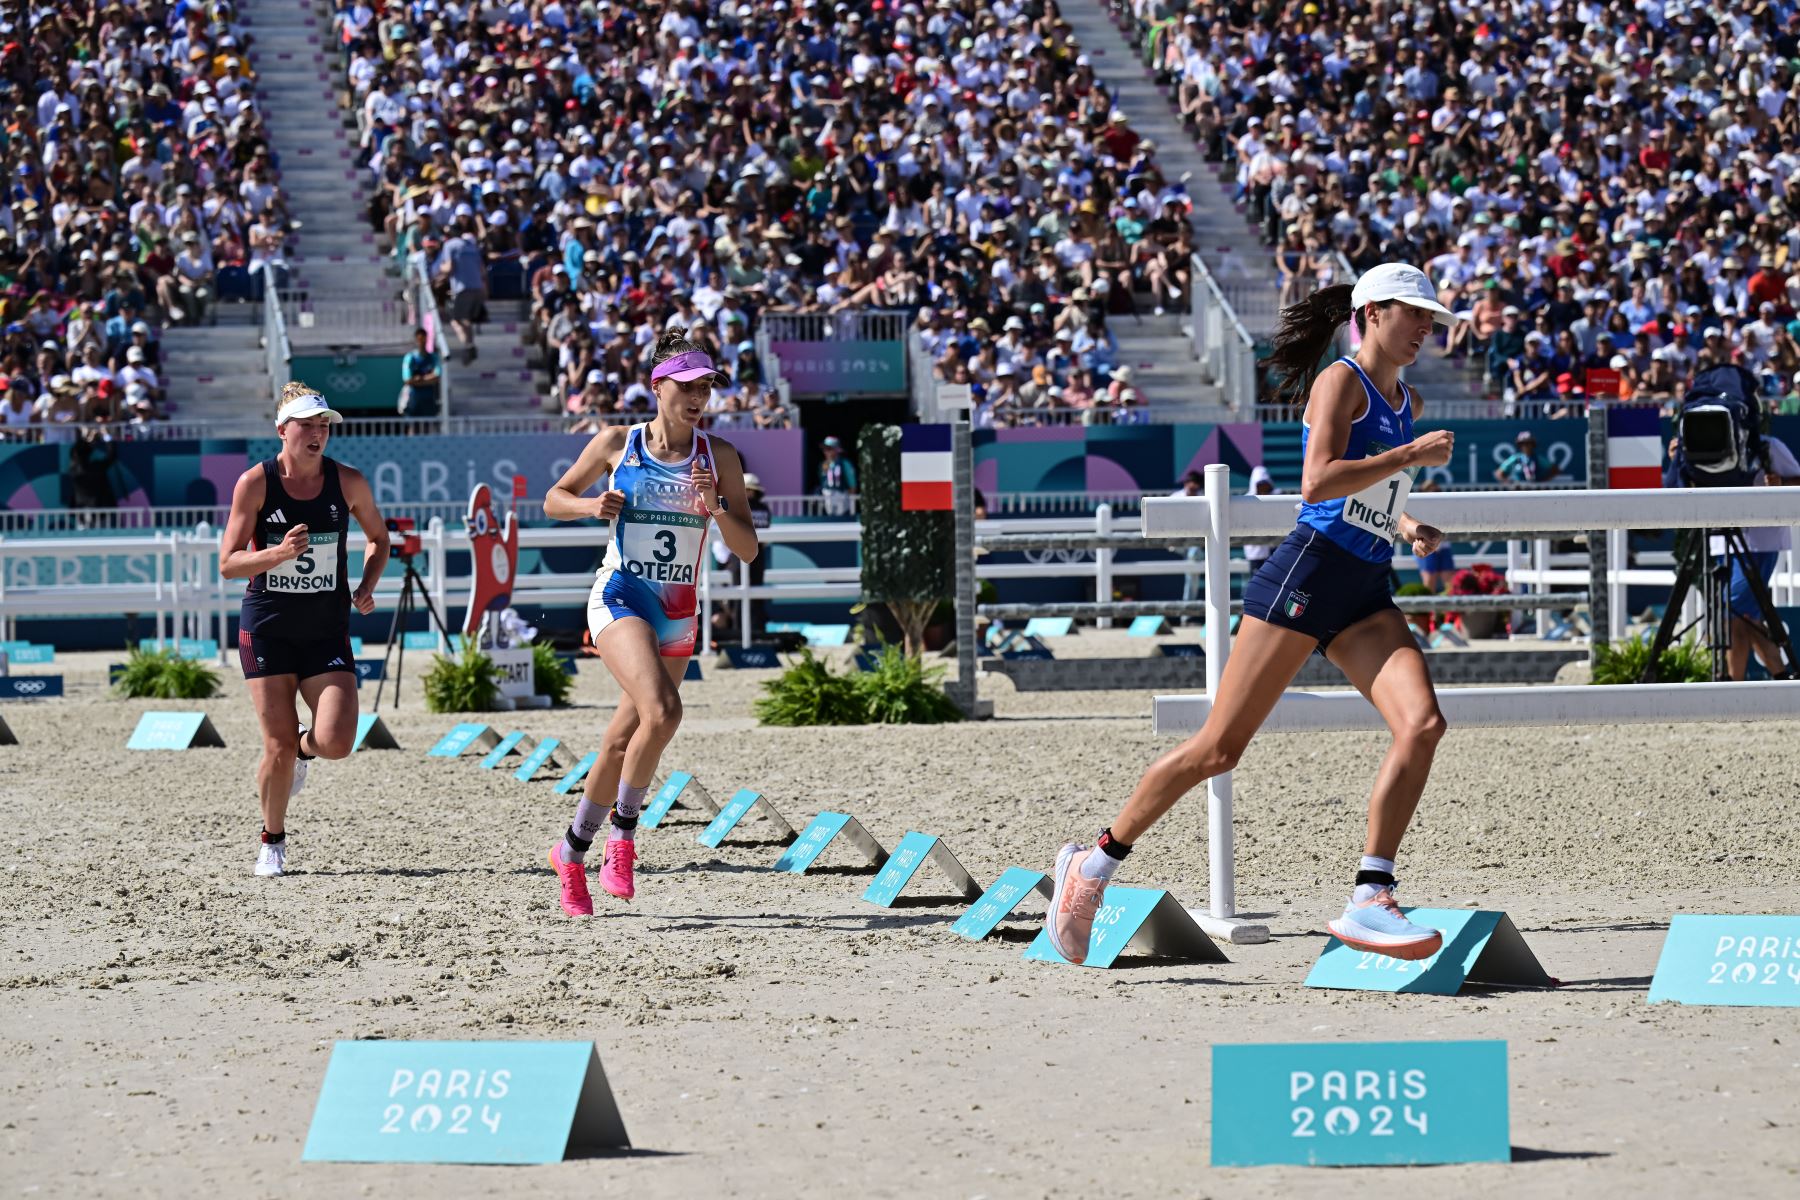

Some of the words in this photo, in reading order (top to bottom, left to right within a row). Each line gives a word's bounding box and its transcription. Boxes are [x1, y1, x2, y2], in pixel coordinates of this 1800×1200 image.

[375, 459, 517, 502] ARiS
[1386, 480, 1399, 515] 1
[295, 548, 315, 575] 5
[653, 530, 677, 563] 3
[269, 574, 333, 589] BRYSON
[627, 560, 693, 582] OTEIZA
[388, 1069, 512, 1099] PARiS
[1290, 1069, 1427, 1101] PARiS
[380, 1104, 502, 1134] 2024
[1290, 1105, 1428, 1137] 2024
